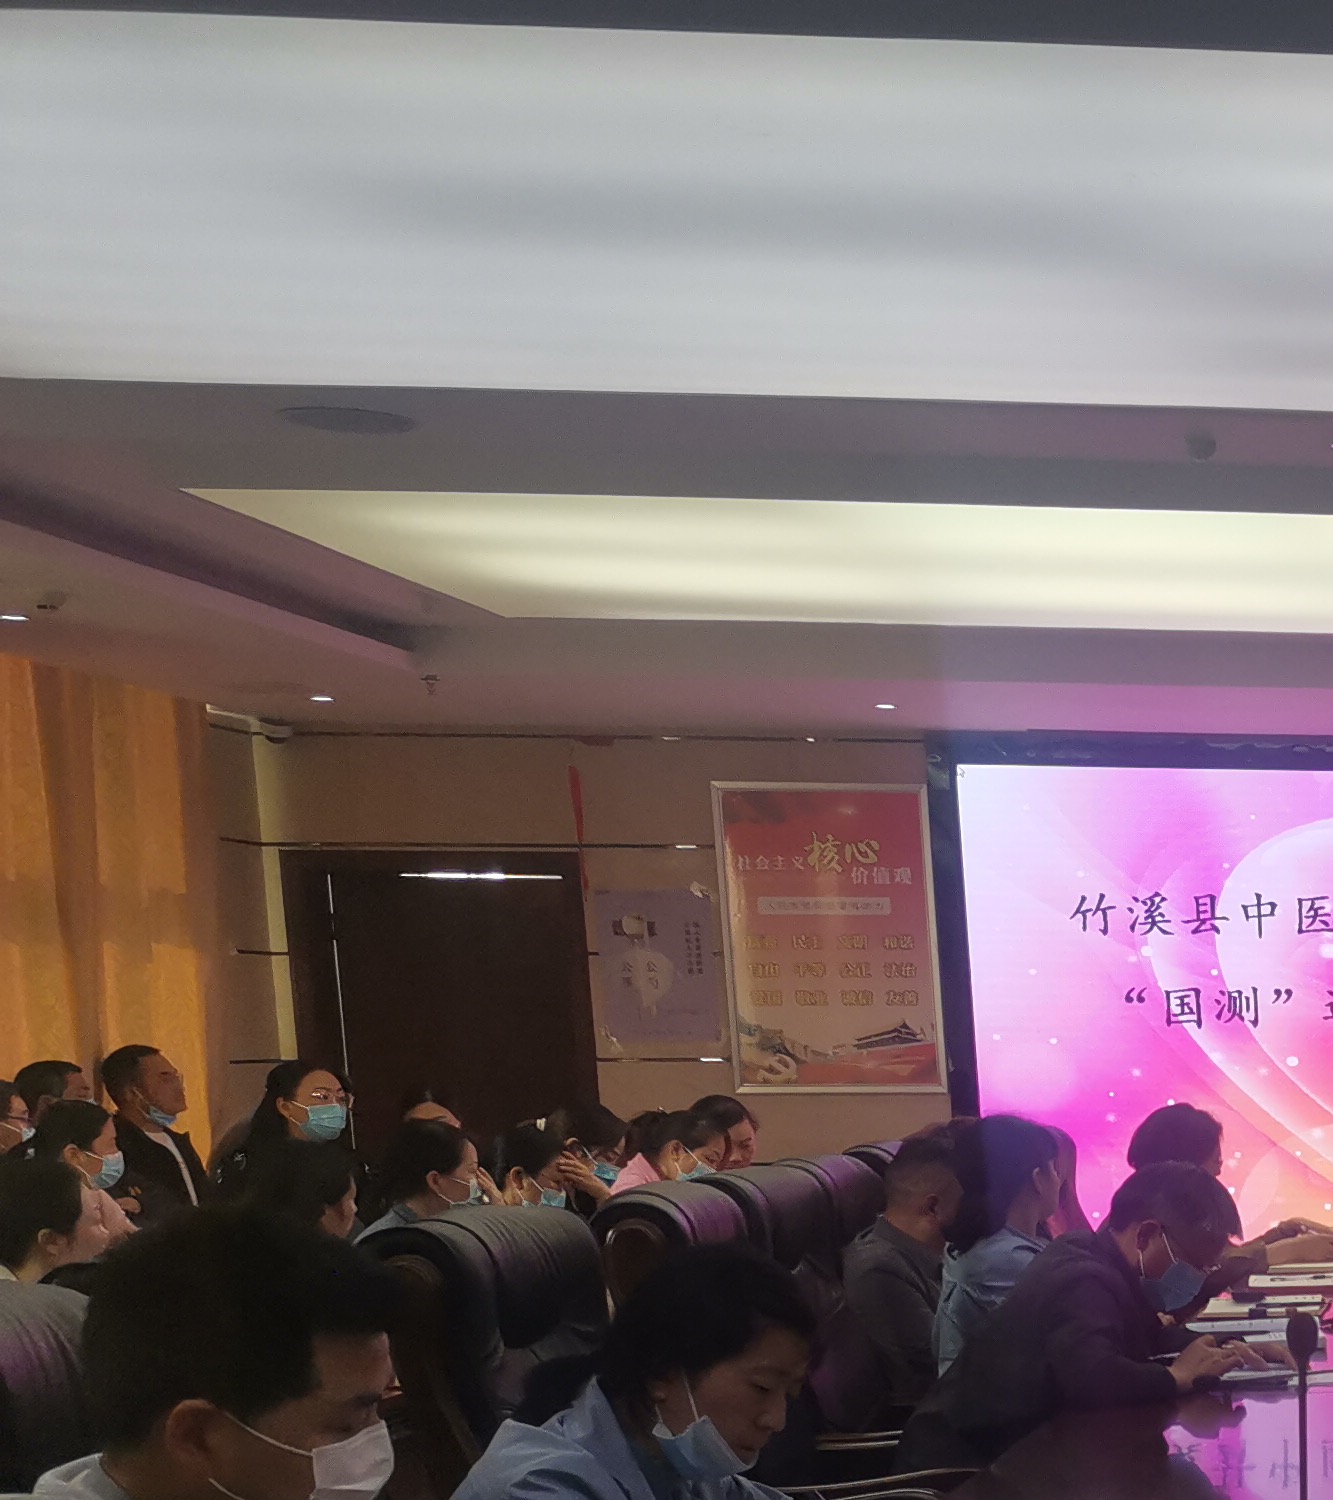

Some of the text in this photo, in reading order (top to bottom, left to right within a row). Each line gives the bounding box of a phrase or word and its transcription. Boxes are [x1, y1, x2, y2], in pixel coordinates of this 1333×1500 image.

[804, 831, 880, 873] 核心
[851, 866, 912, 884] 价值观
